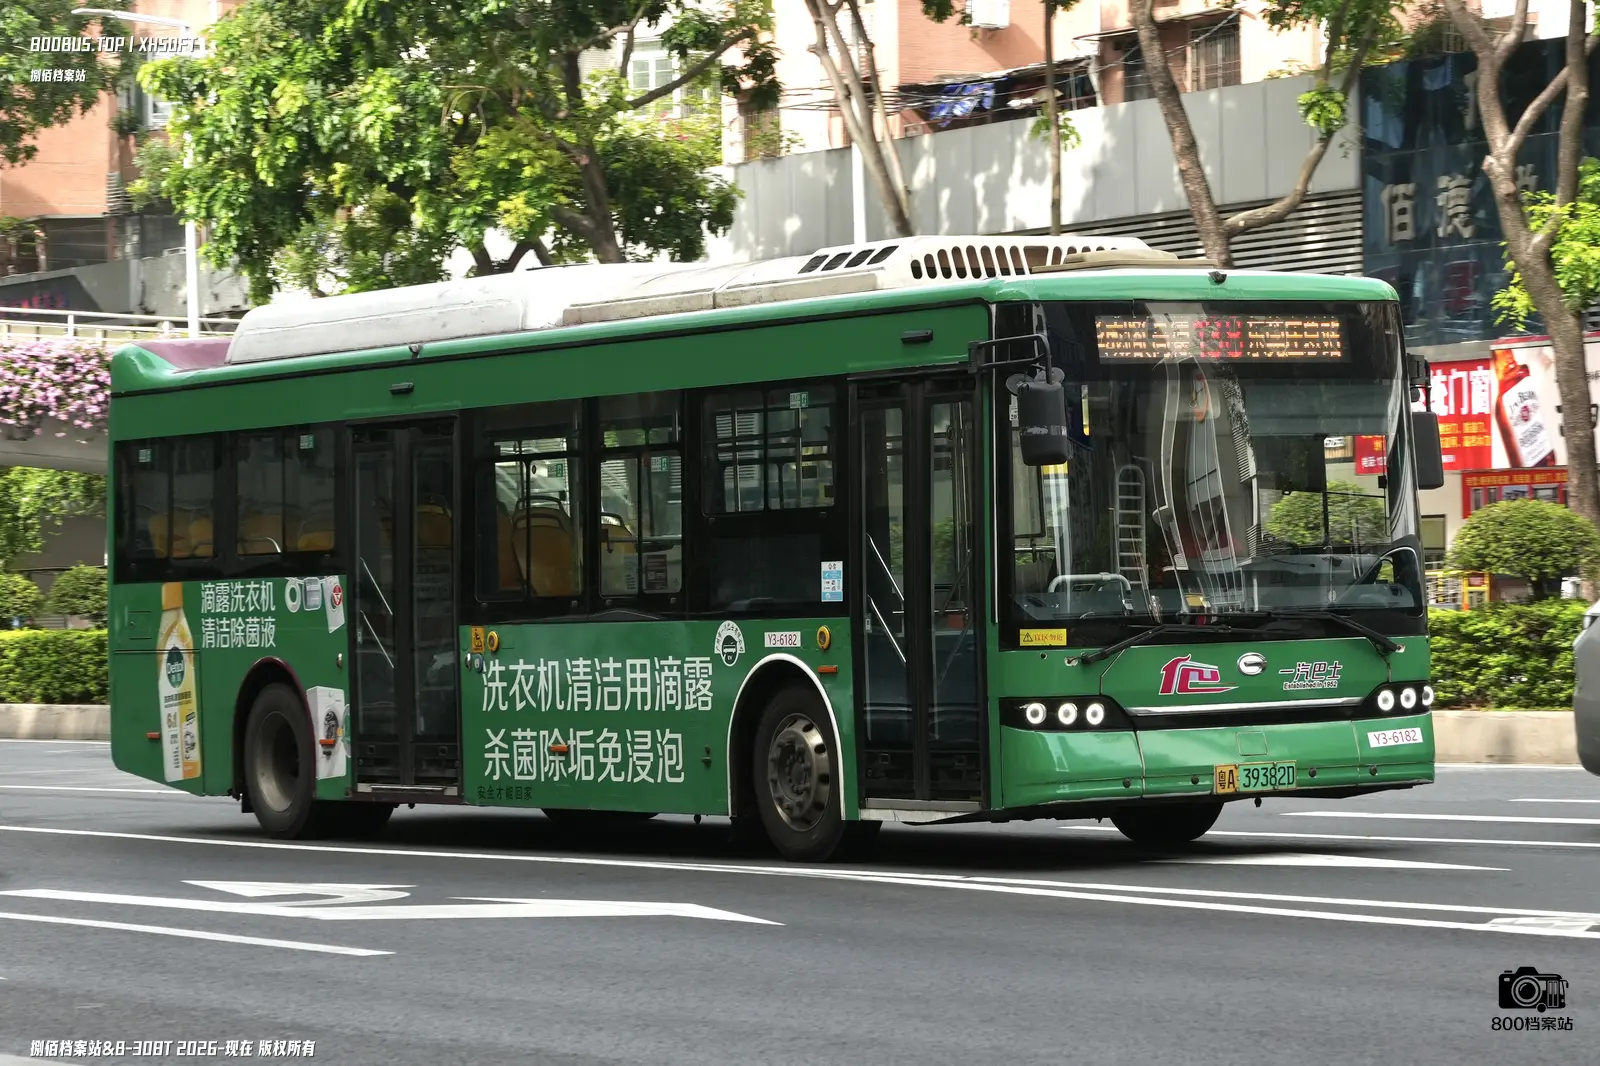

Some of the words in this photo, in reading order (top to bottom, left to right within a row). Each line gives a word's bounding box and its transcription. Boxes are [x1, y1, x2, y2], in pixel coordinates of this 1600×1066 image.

[201, 581, 275, 613] 滴露洗衣机
[202, 617, 276, 648] 清洁除菌液
[768, 634, 797, 646] Y3-6182
[482, 656, 713, 712] 洗衣机清洁用滴露
[1279, 661, 1343, 681] 一汽巴士
[1374, 730, 1418, 745] Y3-6182
[484, 728, 685, 784] 杀菌除垢免浸泡
[1243, 765, 1295, 788] 39382D
